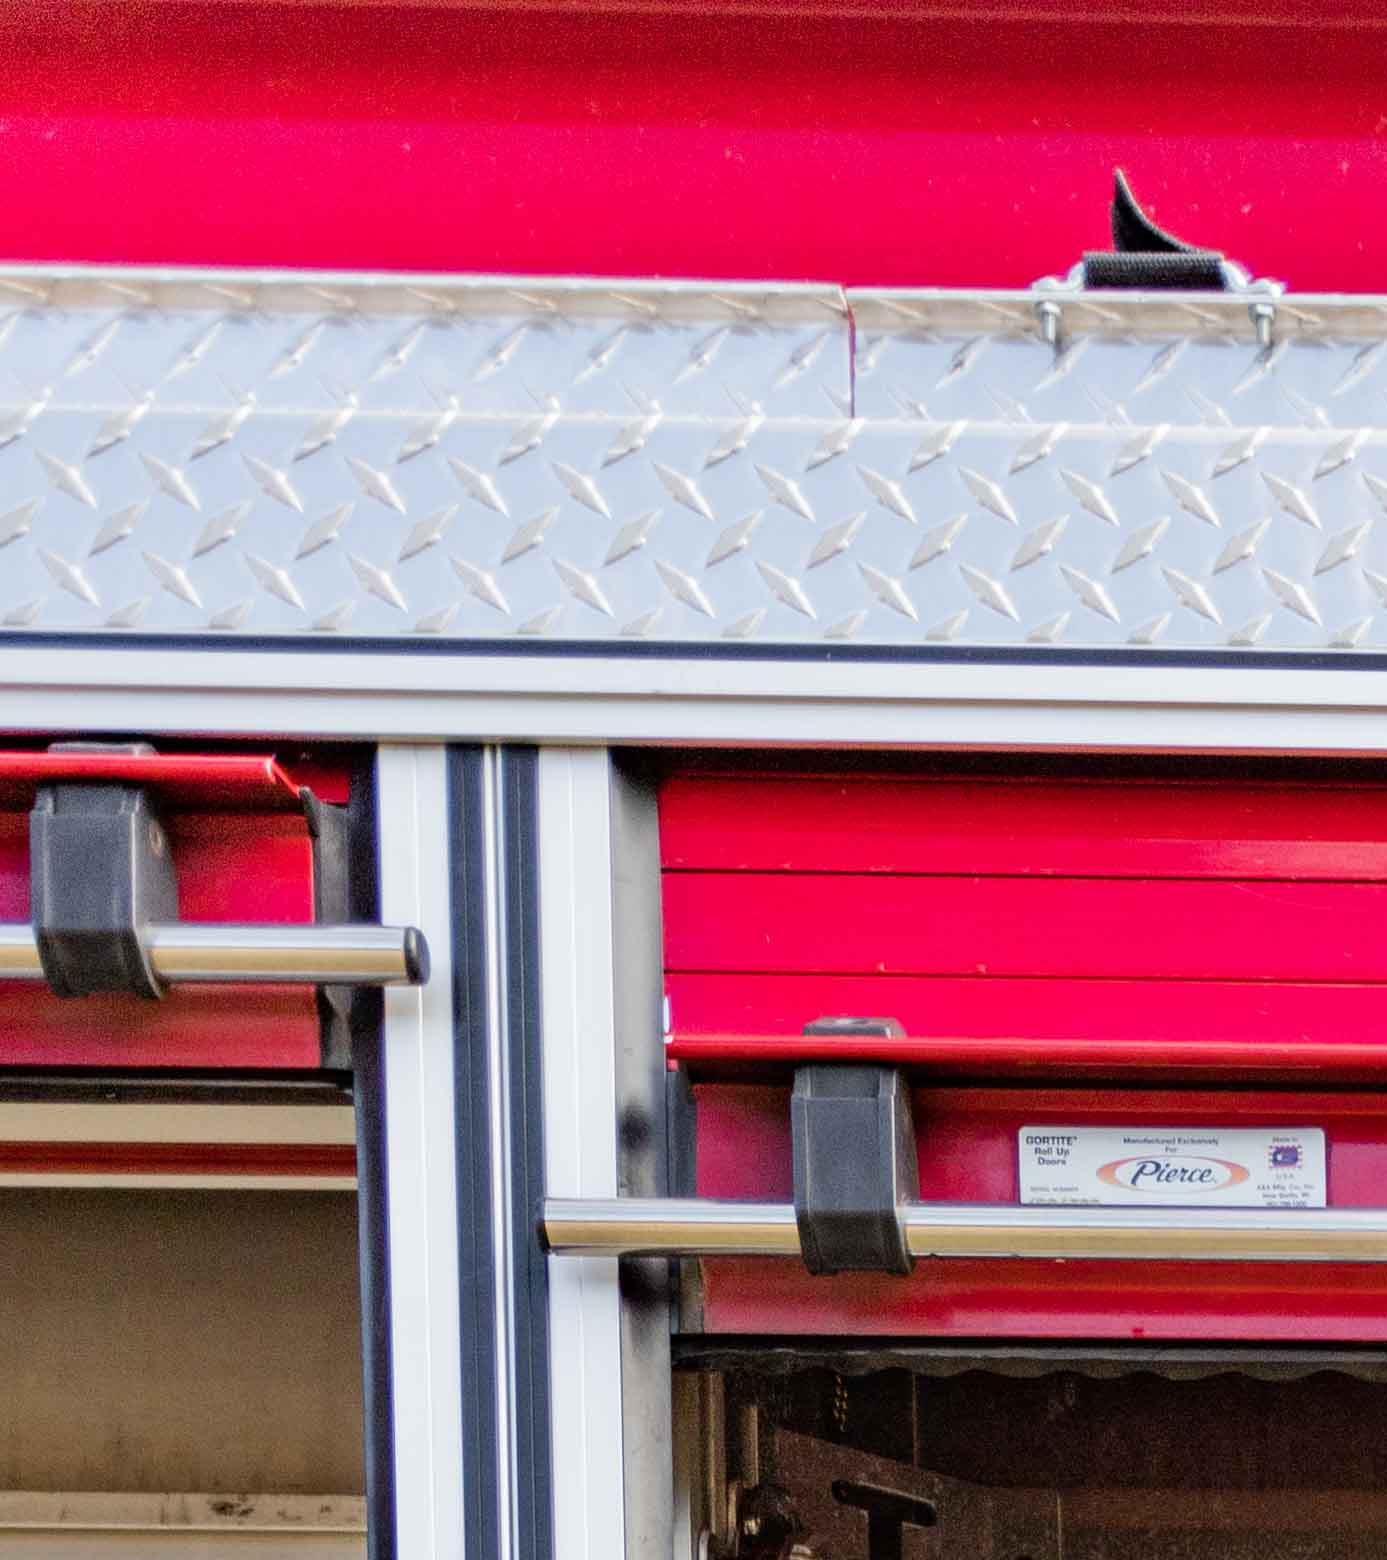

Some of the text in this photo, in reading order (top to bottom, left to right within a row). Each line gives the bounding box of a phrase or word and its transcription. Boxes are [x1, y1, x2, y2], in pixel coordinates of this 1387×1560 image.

[1034, 1147, 1070, 1157] Roll Up
[1037, 1157, 1067, 1166] Doors
[1131, 1160, 1212, 1186] Pierce
